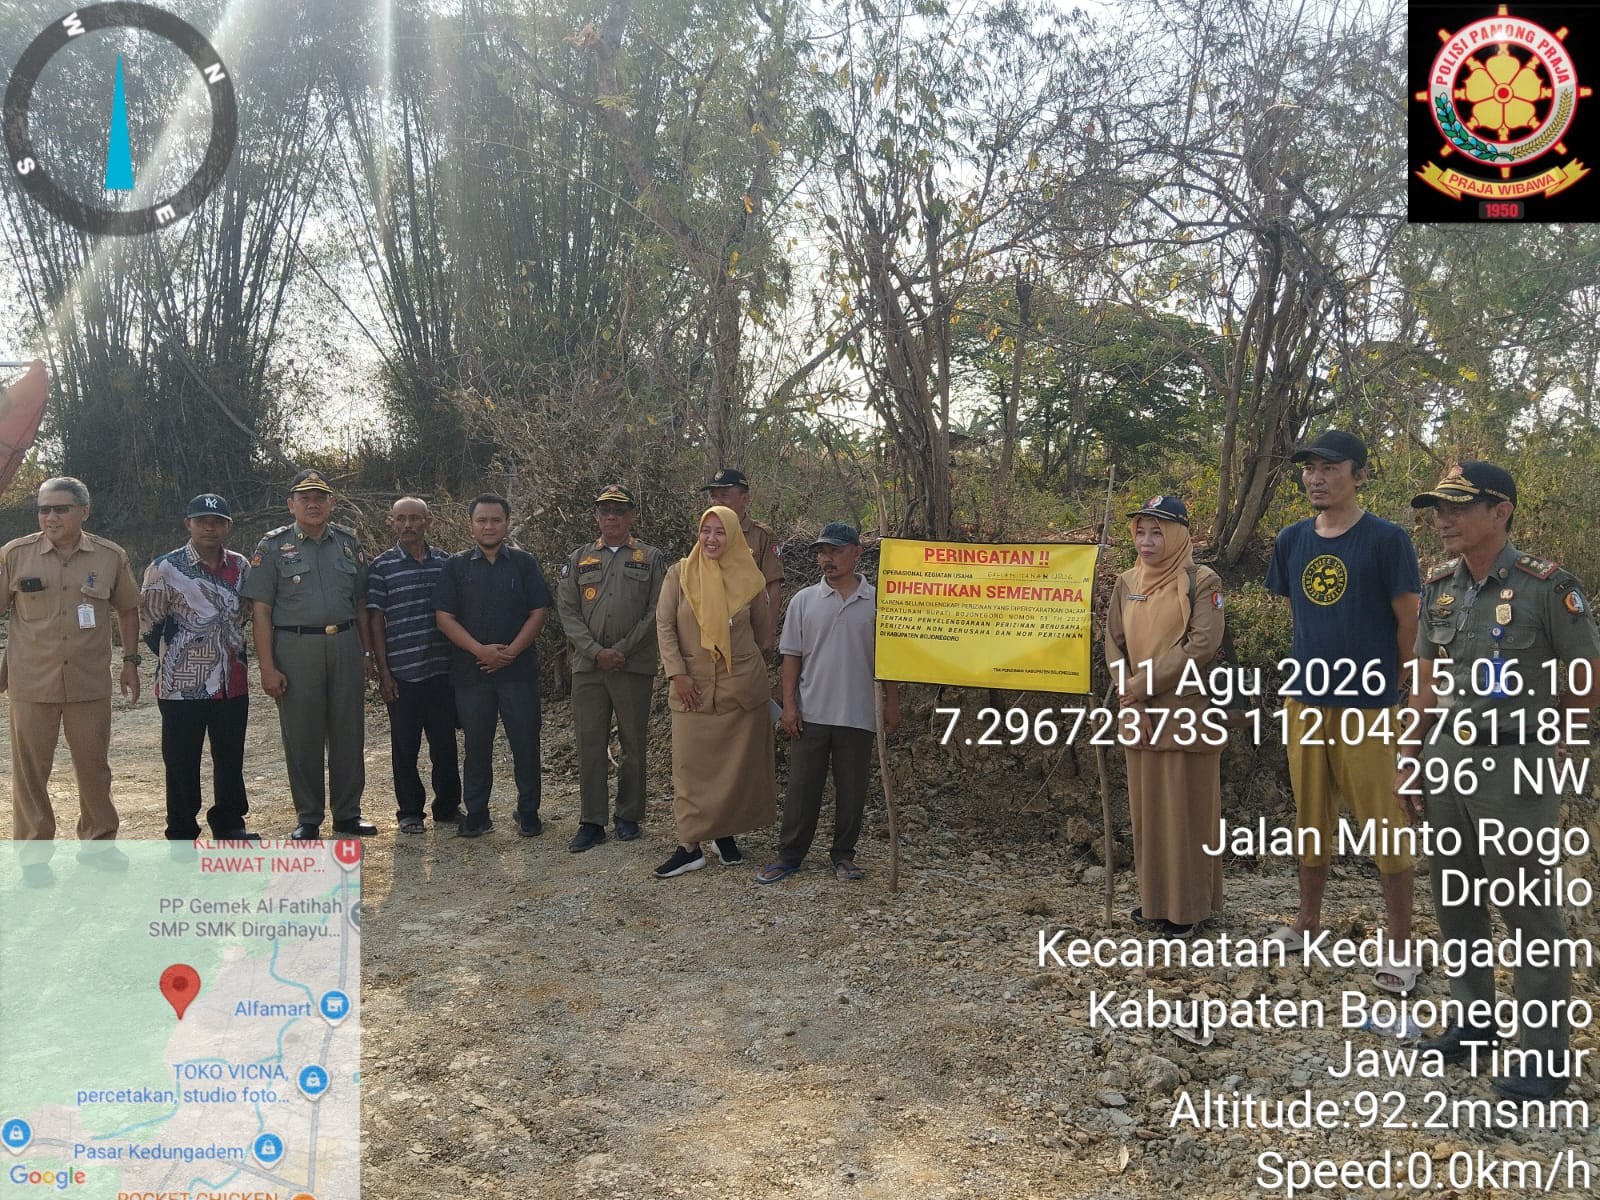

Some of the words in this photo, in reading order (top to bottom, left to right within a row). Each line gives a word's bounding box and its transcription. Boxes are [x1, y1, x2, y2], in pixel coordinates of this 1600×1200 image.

[924, 548, 1034, 565] PERINGATAN
[1039, 551, 1050, 565] !!
[883, 569, 922, 577] OPERASIONAL
[925, 571, 953, 579] KEGIATAN
[886, 581, 981, 598] DIHENTIKAN
[986, 586, 1084, 603] SEMENTARA
[881, 606, 922, 615] PERATURAN
[955, 611, 1004, 619] BOJONEGORO
[961, 603, 992, 611] PERIZINAN
[880, 614, 913, 622] TENTANG
[917, 617, 991, 627] PENYELENGGARAAN
[995, 621, 1036, 629] PERIZINAN
[880, 622, 922, 631] PERIZINAN
[947, 627, 990, 635] BERUSAHA
[1037, 631, 1083, 639] PERIZINAN
[886, 631, 919, 639] KABUPATEN
[919, 633, 960, 641] BOJONEGORO
